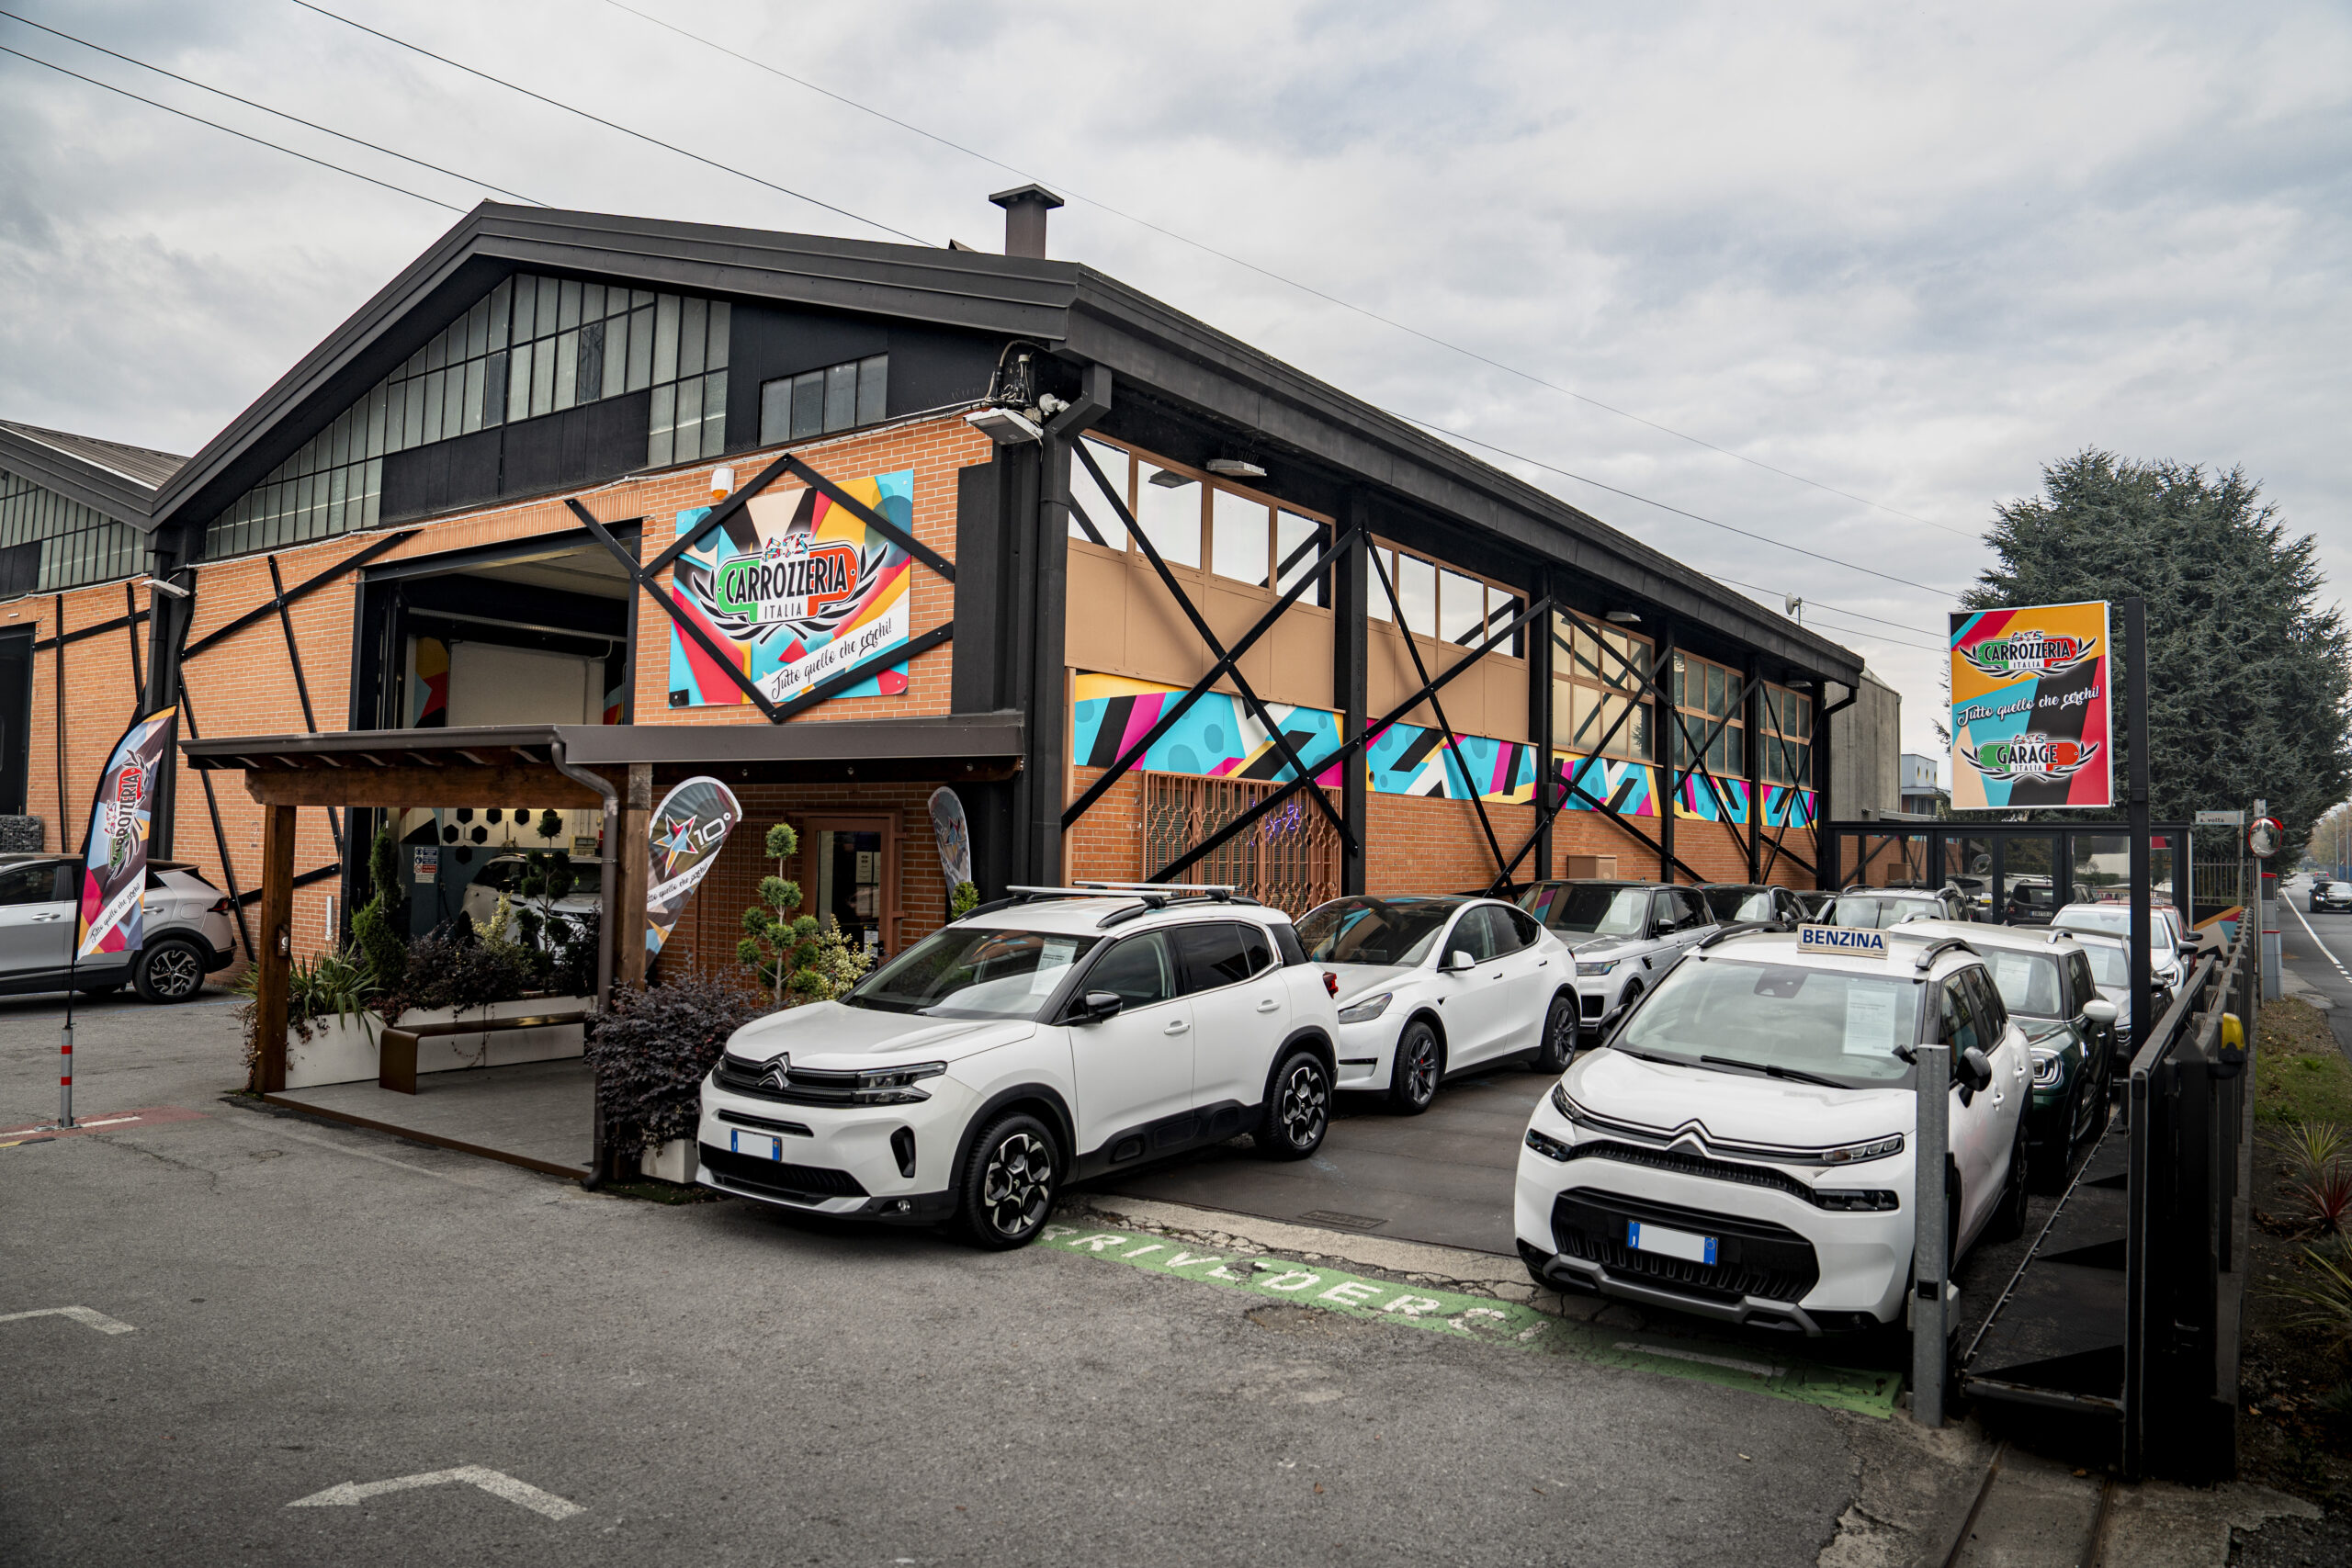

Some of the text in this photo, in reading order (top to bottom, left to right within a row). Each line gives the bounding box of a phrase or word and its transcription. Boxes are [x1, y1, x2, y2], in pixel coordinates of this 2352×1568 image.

[726, 554, 848, 604] CARROZZERIA
[764, 602, 802, 620] ITALIA
[771, 617, 891, 700] Tutto quello che cerchi!
[1984, 641, 2071, 661] CARROZZERIA
[1957, 685, 2099, 727] Tutto quello che cerchi!
[1996, 745, 2057, 764] GARAGE
[1802, 929, 1884, 949] BENZINA
